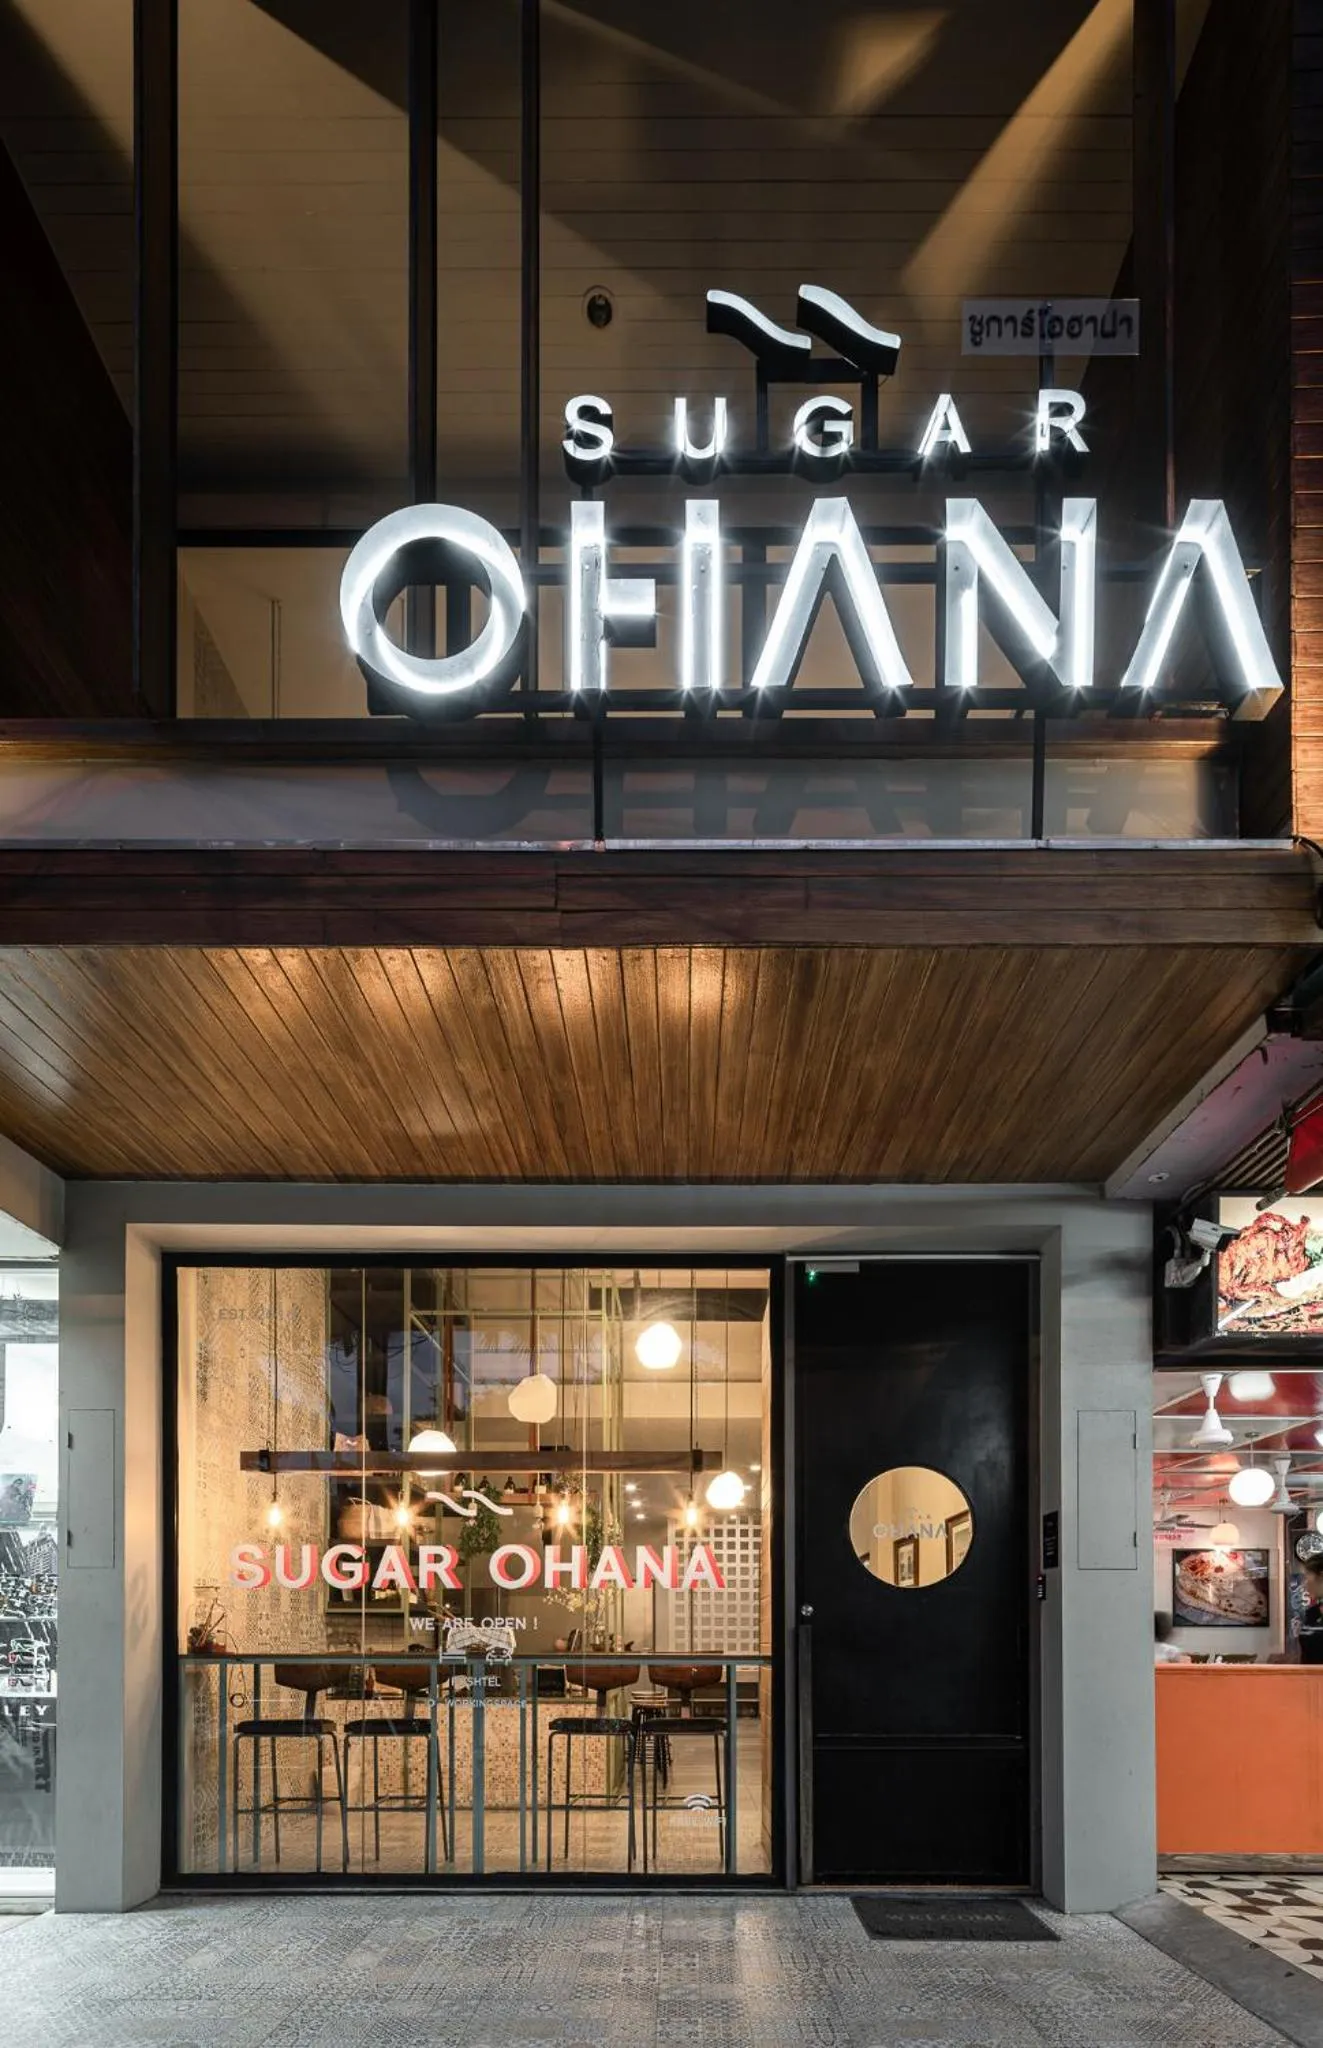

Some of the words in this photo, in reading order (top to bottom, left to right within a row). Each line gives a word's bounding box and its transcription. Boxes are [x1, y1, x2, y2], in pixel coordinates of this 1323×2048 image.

[563, 389, 1090, 462] SUGAR
[339, 497, 1285, 704] OHANA
[228, 1543, 464, 1591] SUGAR
[488, 1543, 727, 1591] OHANA
[409, 1617, 435, 1631] WE
[442, 1617, 475, 1631] ARE
[481, 1617, 527, 1631] OPEN
